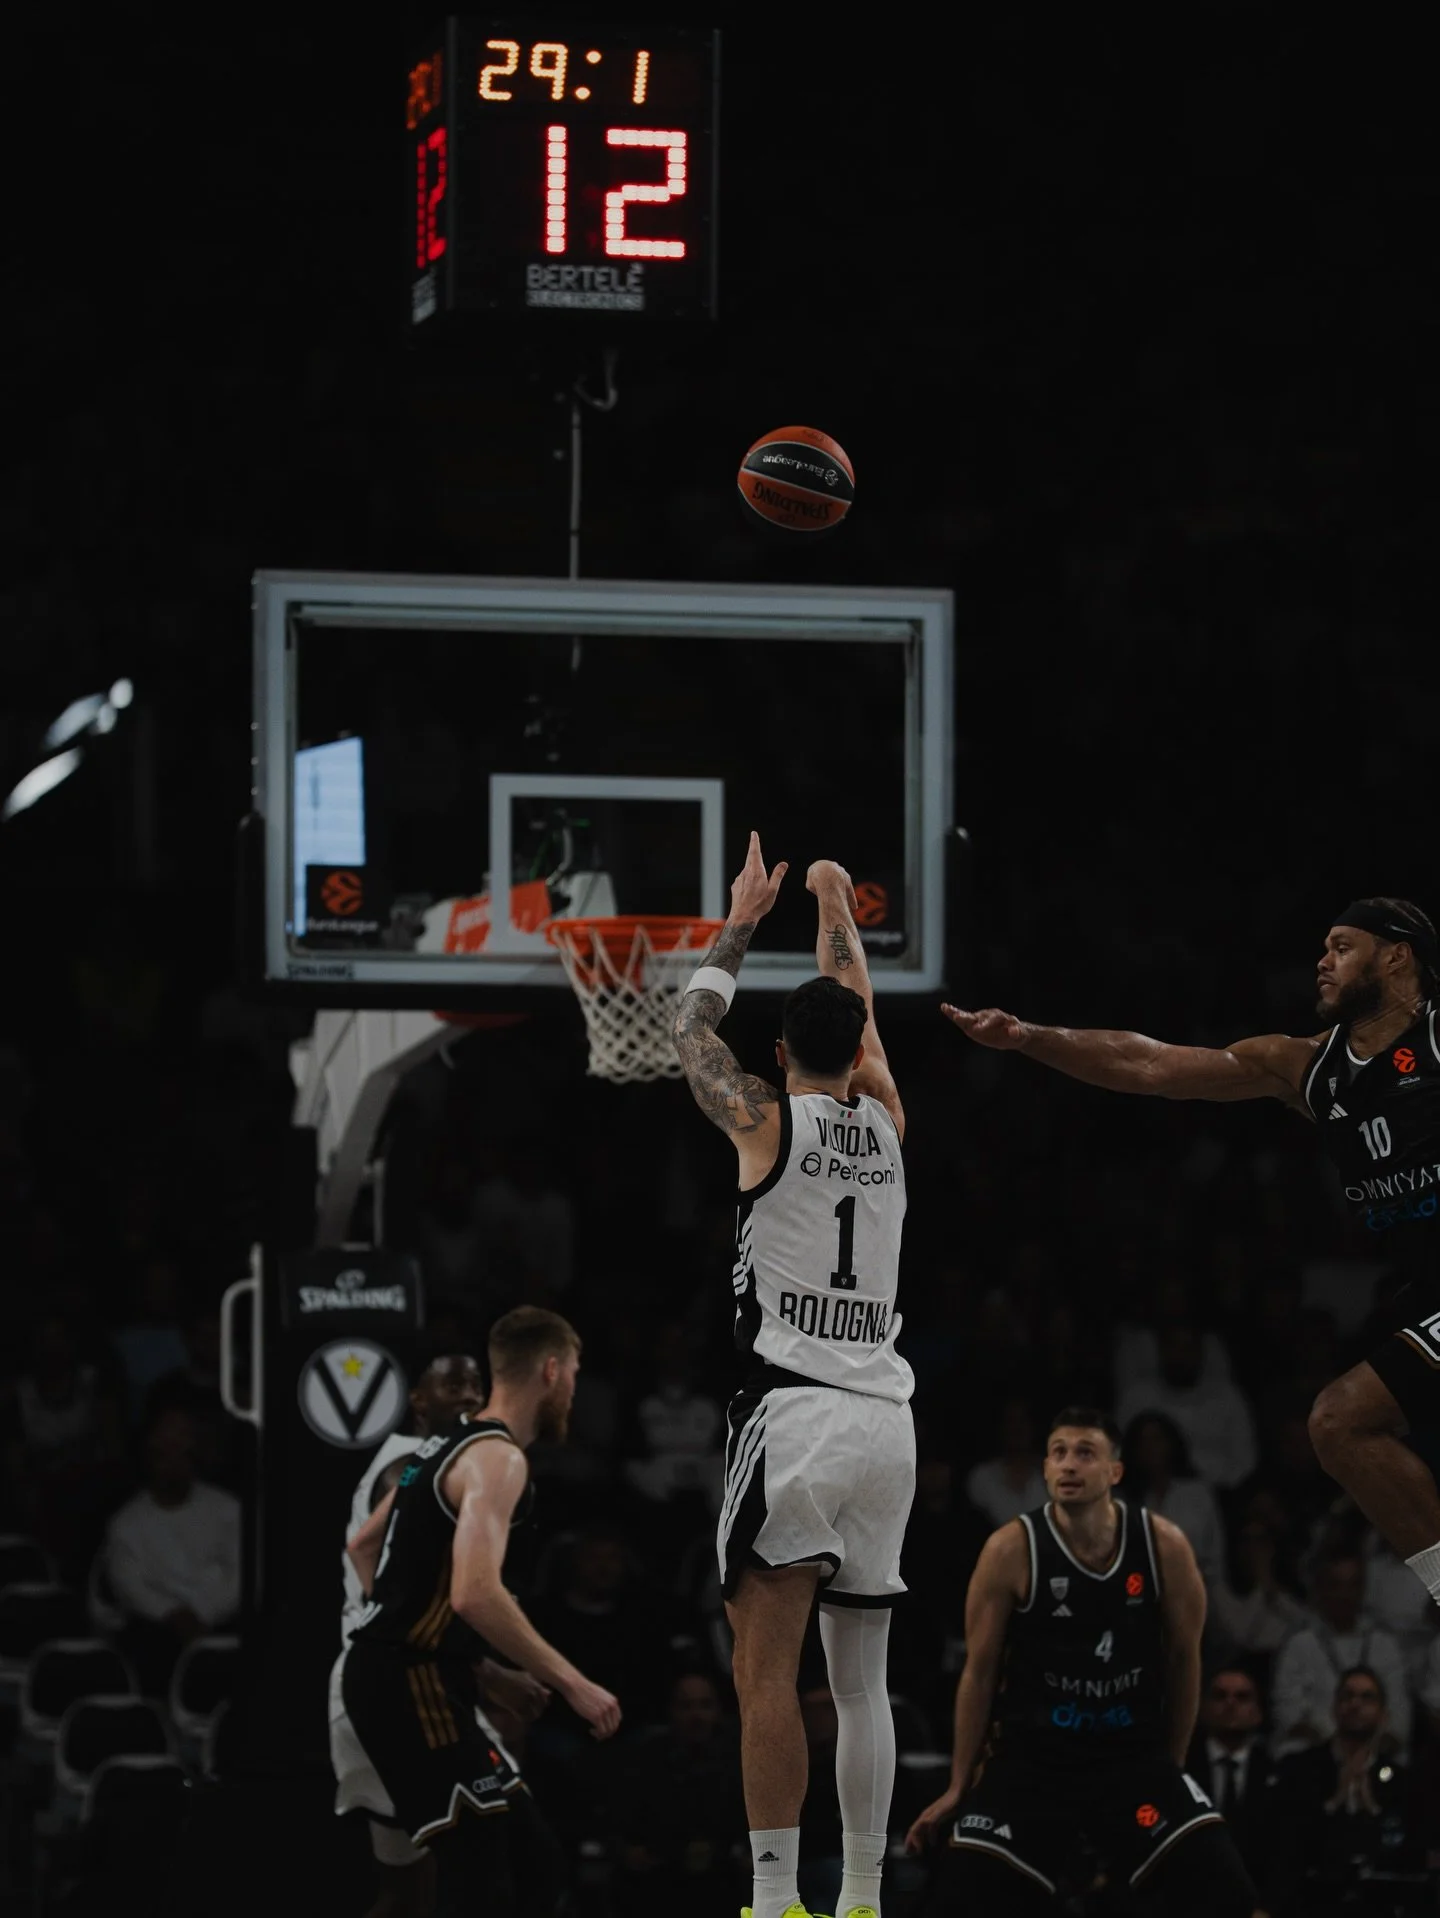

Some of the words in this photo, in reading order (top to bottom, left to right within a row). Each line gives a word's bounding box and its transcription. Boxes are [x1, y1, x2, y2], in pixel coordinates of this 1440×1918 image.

[547, 124, 687, 260] 12
[1358, 1116, 1392, 1160] 10
[830, 1196, 856, 1290] 1
[779, 1291, 887, 1344] BOLOGNA
[1094, 1628, 1113, 1663] 4
